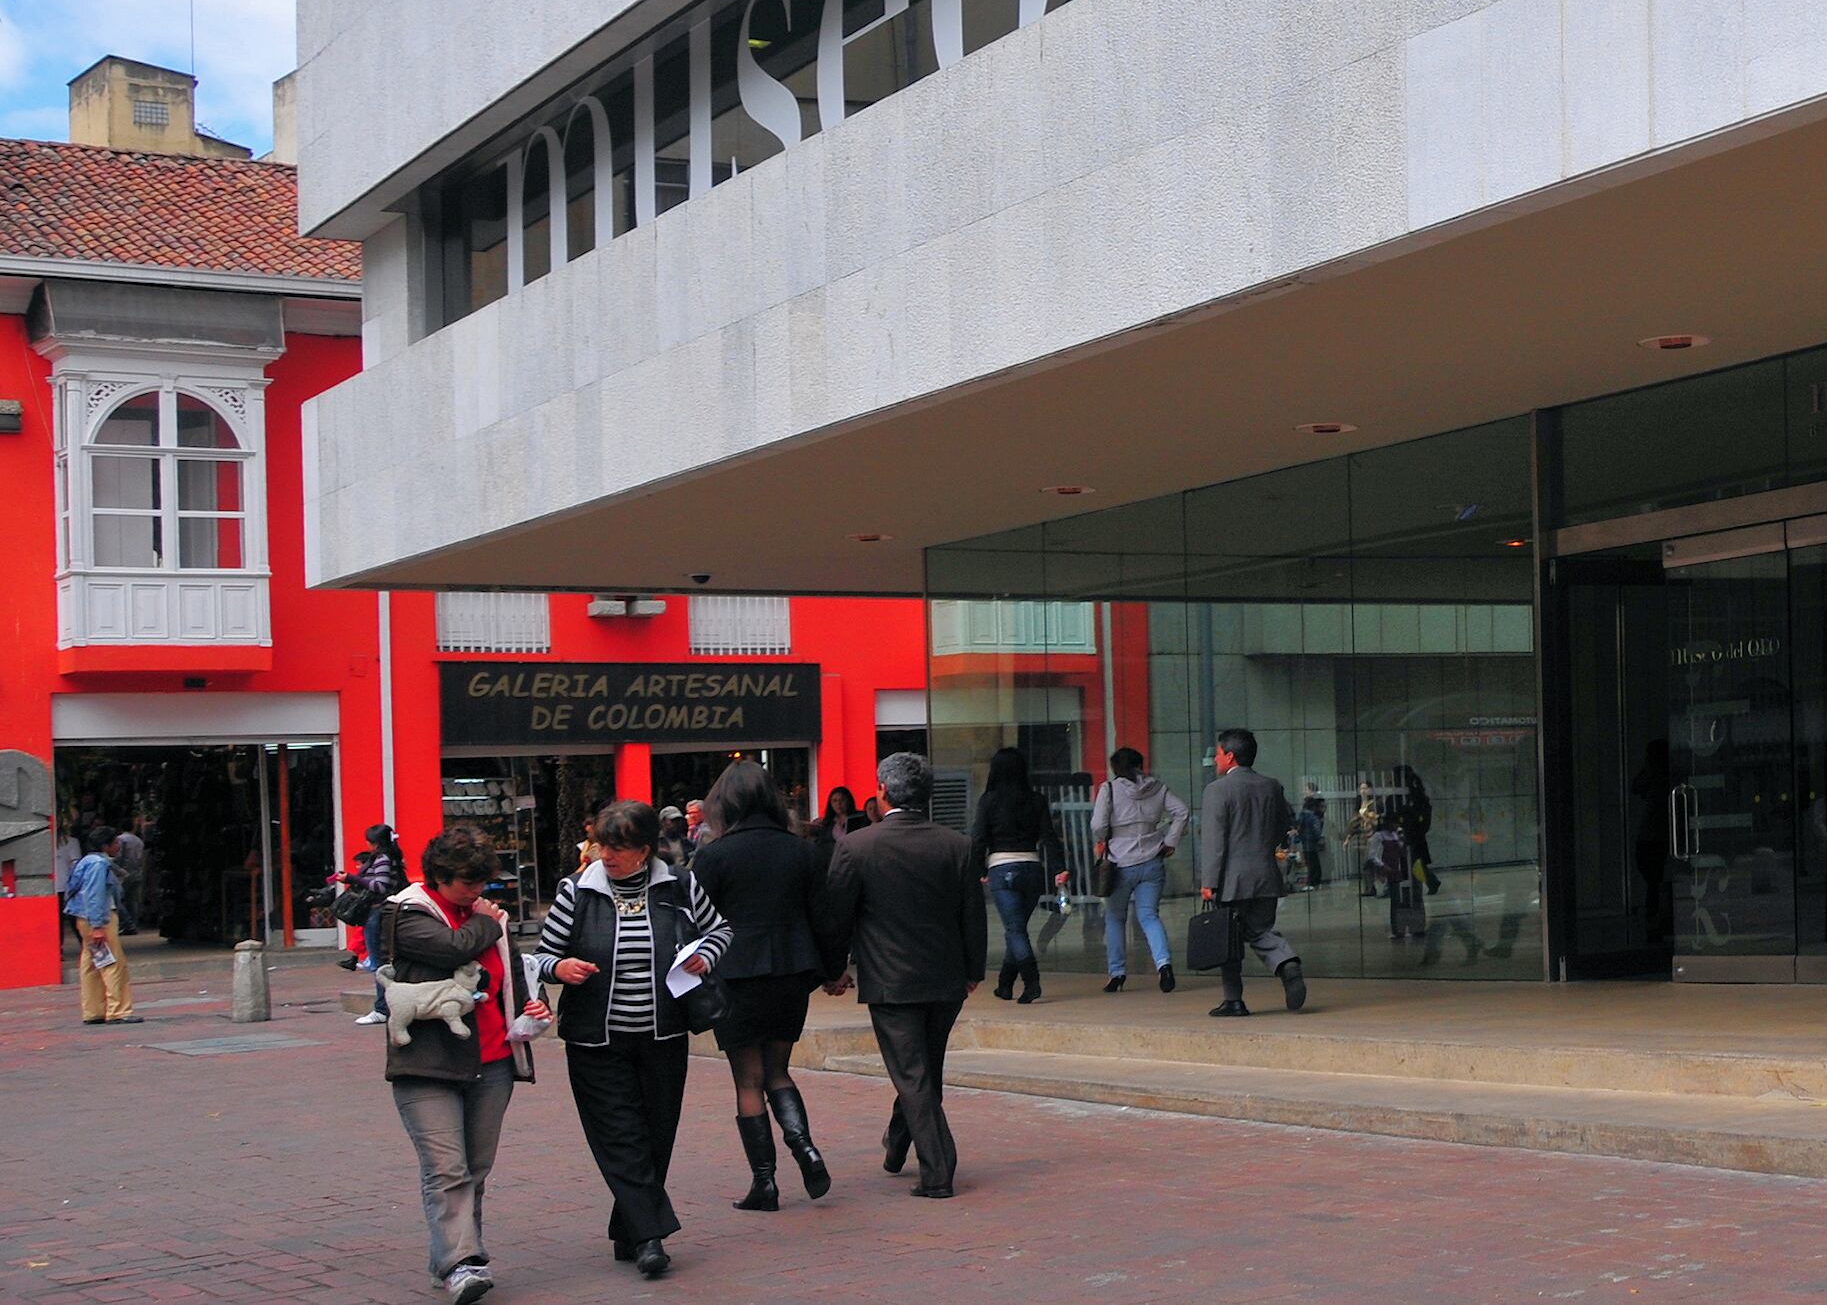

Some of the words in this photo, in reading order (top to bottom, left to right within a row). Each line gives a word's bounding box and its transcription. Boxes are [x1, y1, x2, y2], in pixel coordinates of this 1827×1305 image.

[467, 671, 609, 698] GALERIA
[625, 673, 798, 699] ARTESANAL
[531, 704, 574, 731] DE
[587, 703, 745, 731] COLOMBIA
